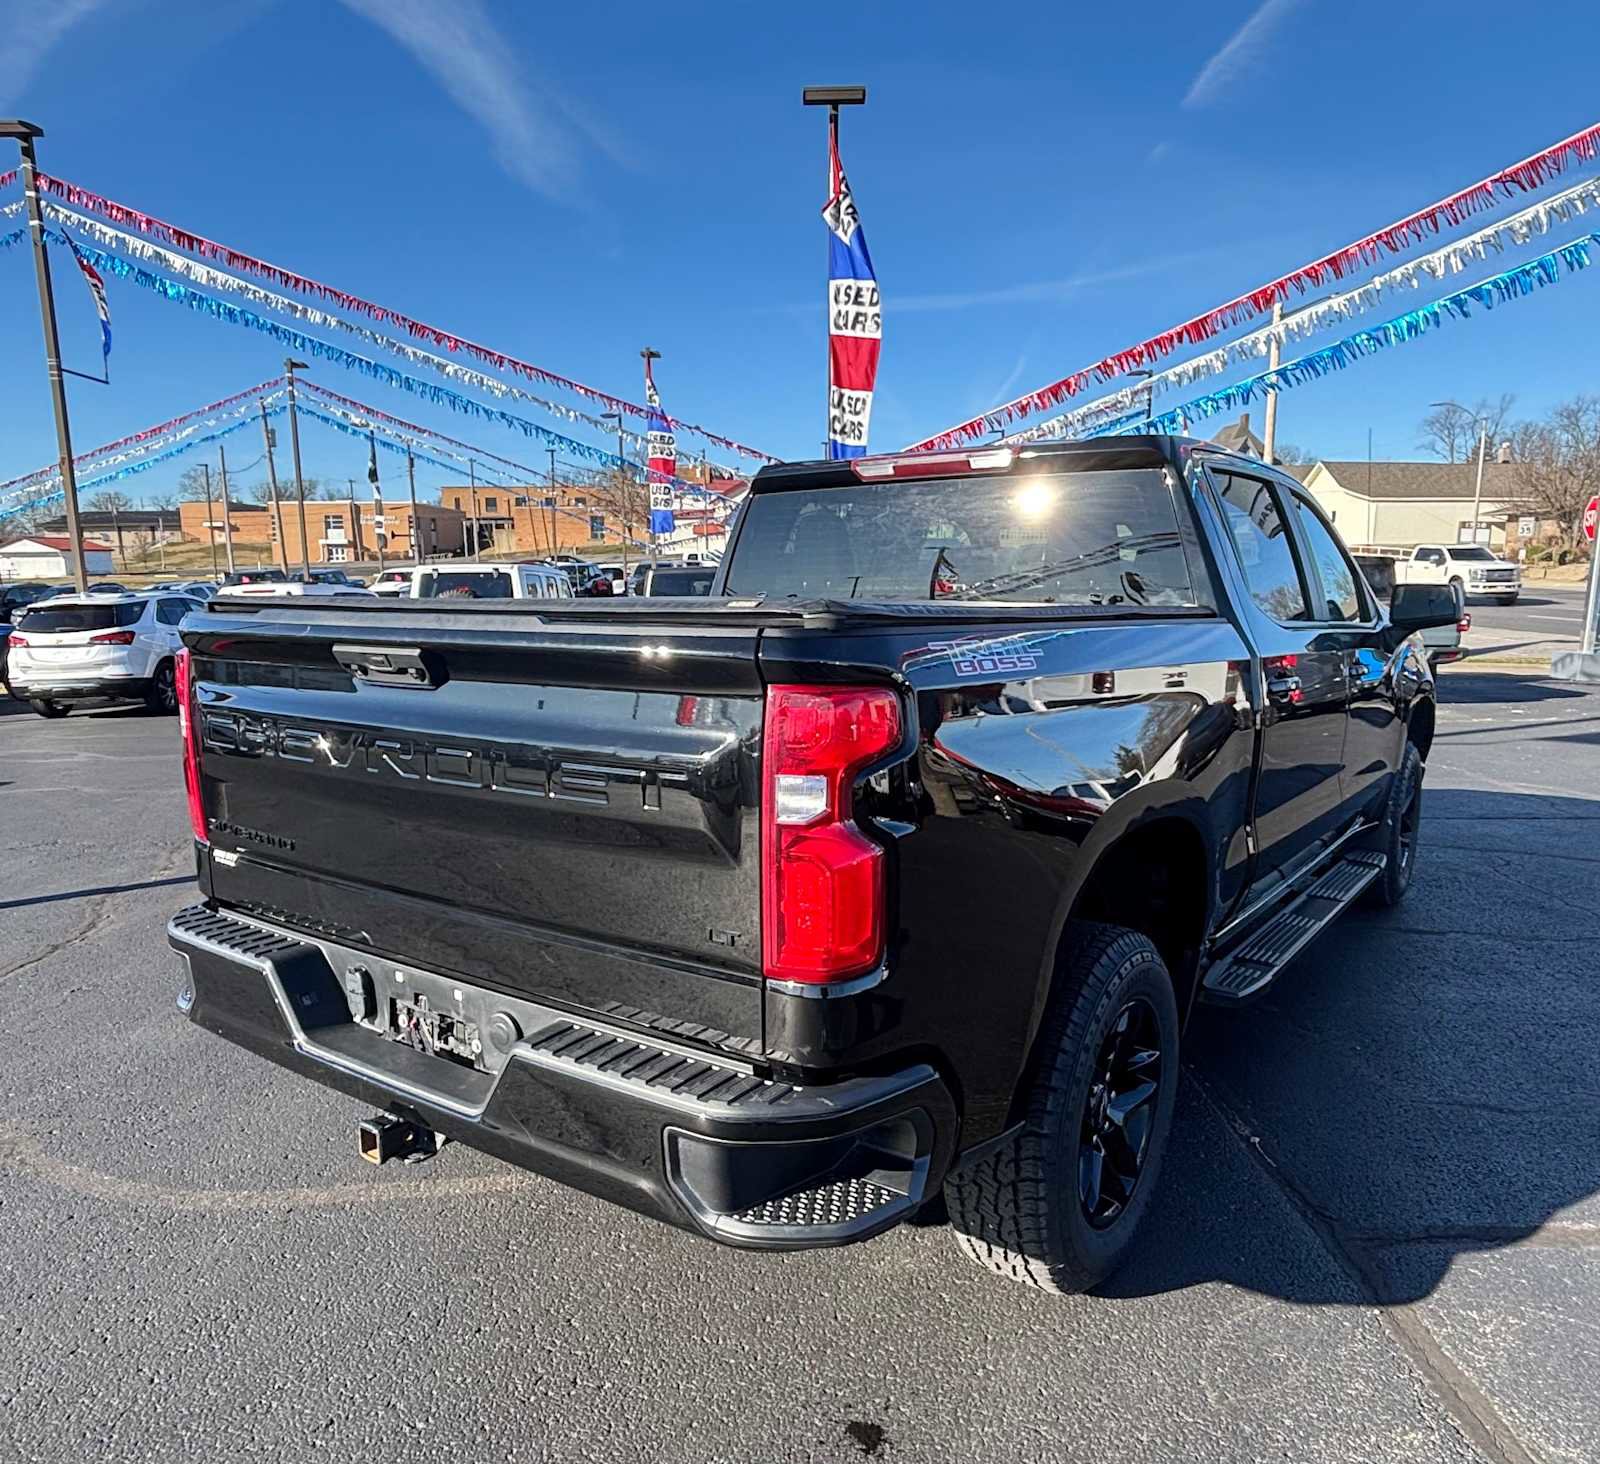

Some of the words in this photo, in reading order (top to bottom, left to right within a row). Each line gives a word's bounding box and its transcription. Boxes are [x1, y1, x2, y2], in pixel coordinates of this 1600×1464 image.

[951, 656, 1036, 676] BOSS
[202, 708, 690, 810] CHEVROLET
[704, 927, 739, 947] LT
